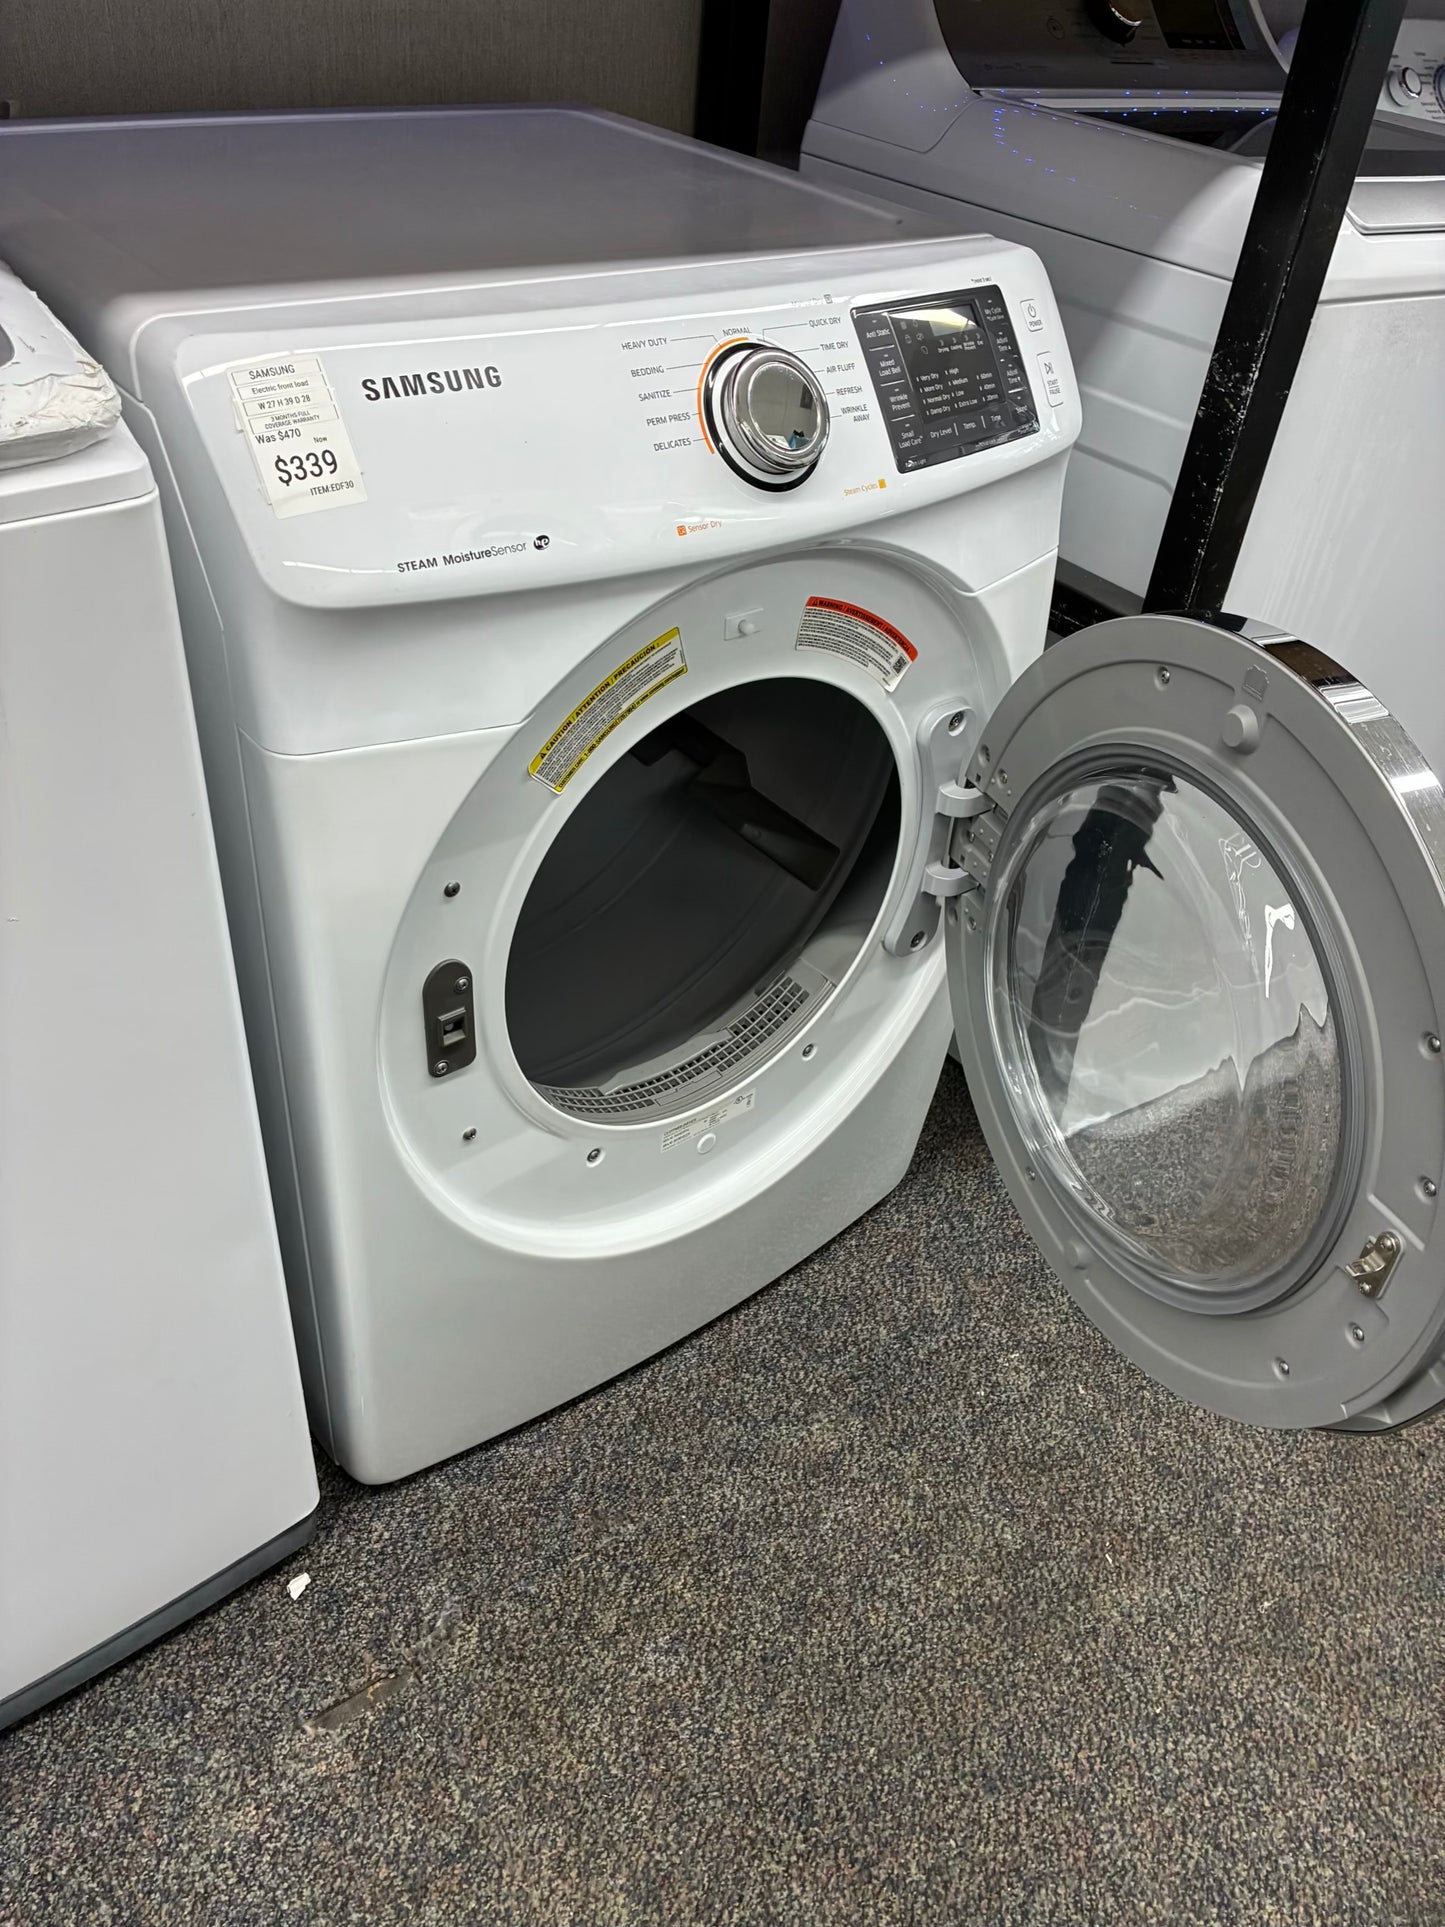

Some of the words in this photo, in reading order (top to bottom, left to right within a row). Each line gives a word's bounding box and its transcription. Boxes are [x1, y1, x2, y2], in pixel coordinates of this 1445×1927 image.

[809, 319, 827, 328] QUICK
[828, 317, 841, 325] DRY
[722, 327, 751, 336] NORMAL
[878, 328, 890, 337] Static
[622, 340, 645, 351] HEAVY
[648, 338, 667, 347] DUTY
[820, 343, 833, 351] TIME
[835, 341, 848, 349] DRY
[825, 366, 836, 374] AIR
[837, 362, 855, 372] FLUFF
[880, 359, 894, 367] Mixed
[248, 364, 295, 380] SAMSUNG
[631, 365, 664, 377] BEDDING
[879, 368, 890, 376] Load
[891, 365, 901, 374] Bell
[948, 367, 959, 376] High
[920, 374, 930, 382] Very
[930, 372, 939, 380] Dry
[951, 377, 968, 385] Medium
[252, 385, 277, 394] Electric
[278, 382, 293, 390] front
[361, 366, 502, 401] SAMSUNG
[924, 384, 934, 392] More
[935, 383, 943, 391] Dry
[638, 389, 671, 401] SANITIZE
[836, 386, 862, 396] REFRESH
[927, 395, 943, 404] Normal
[958, 400, 968, 408] Extra
[258, 402, 265, 410] W
[841, 404, 868, 415] WRINKLE
[892, 402, 910, 410] Prevent
[930, 408, 941, 416] Damp
[942, 405, 950, 413] Dry
[265, 420, 292, 429] COVERAGE
[292, 415, 320, 425] WARRANTY
[646, 415, 667, 426] PERM
[669, 412, 690, 423] PRESS
[853, 414, 870, 422] AWAY
[991, 414, 1001, 422] Time
[255, 434, 276, 444] Was
[278, 428, 301, 441] $470
[901, 431, 914, 439] Small
[930, 431, 939, 439] Dry
[939, 428, 952, 436] Level
[653, 437, 691, 452] DELICATES
[899, 440, 910, 449] Load
[274, 449, 338, 487] $339
[310, 480, 354, 496] ITEM:EDF30
[844, 486, 859, 496] Steam
[860, 482, 877, 493] Cycles
[688, 522, 709, 534] Sensor
[710, 520, 722, 530] Dry
[397, 558, 438, 573] STEAM
[443, 541, 527, 565] MoistureSensor
[819, 600, 842, 610] WARNING
[545, 719, 573, 752] CAUTION
[575, 681, 610, 717] ATTENTION
[613, 644, 656, 679] PRECAUCIÓN
